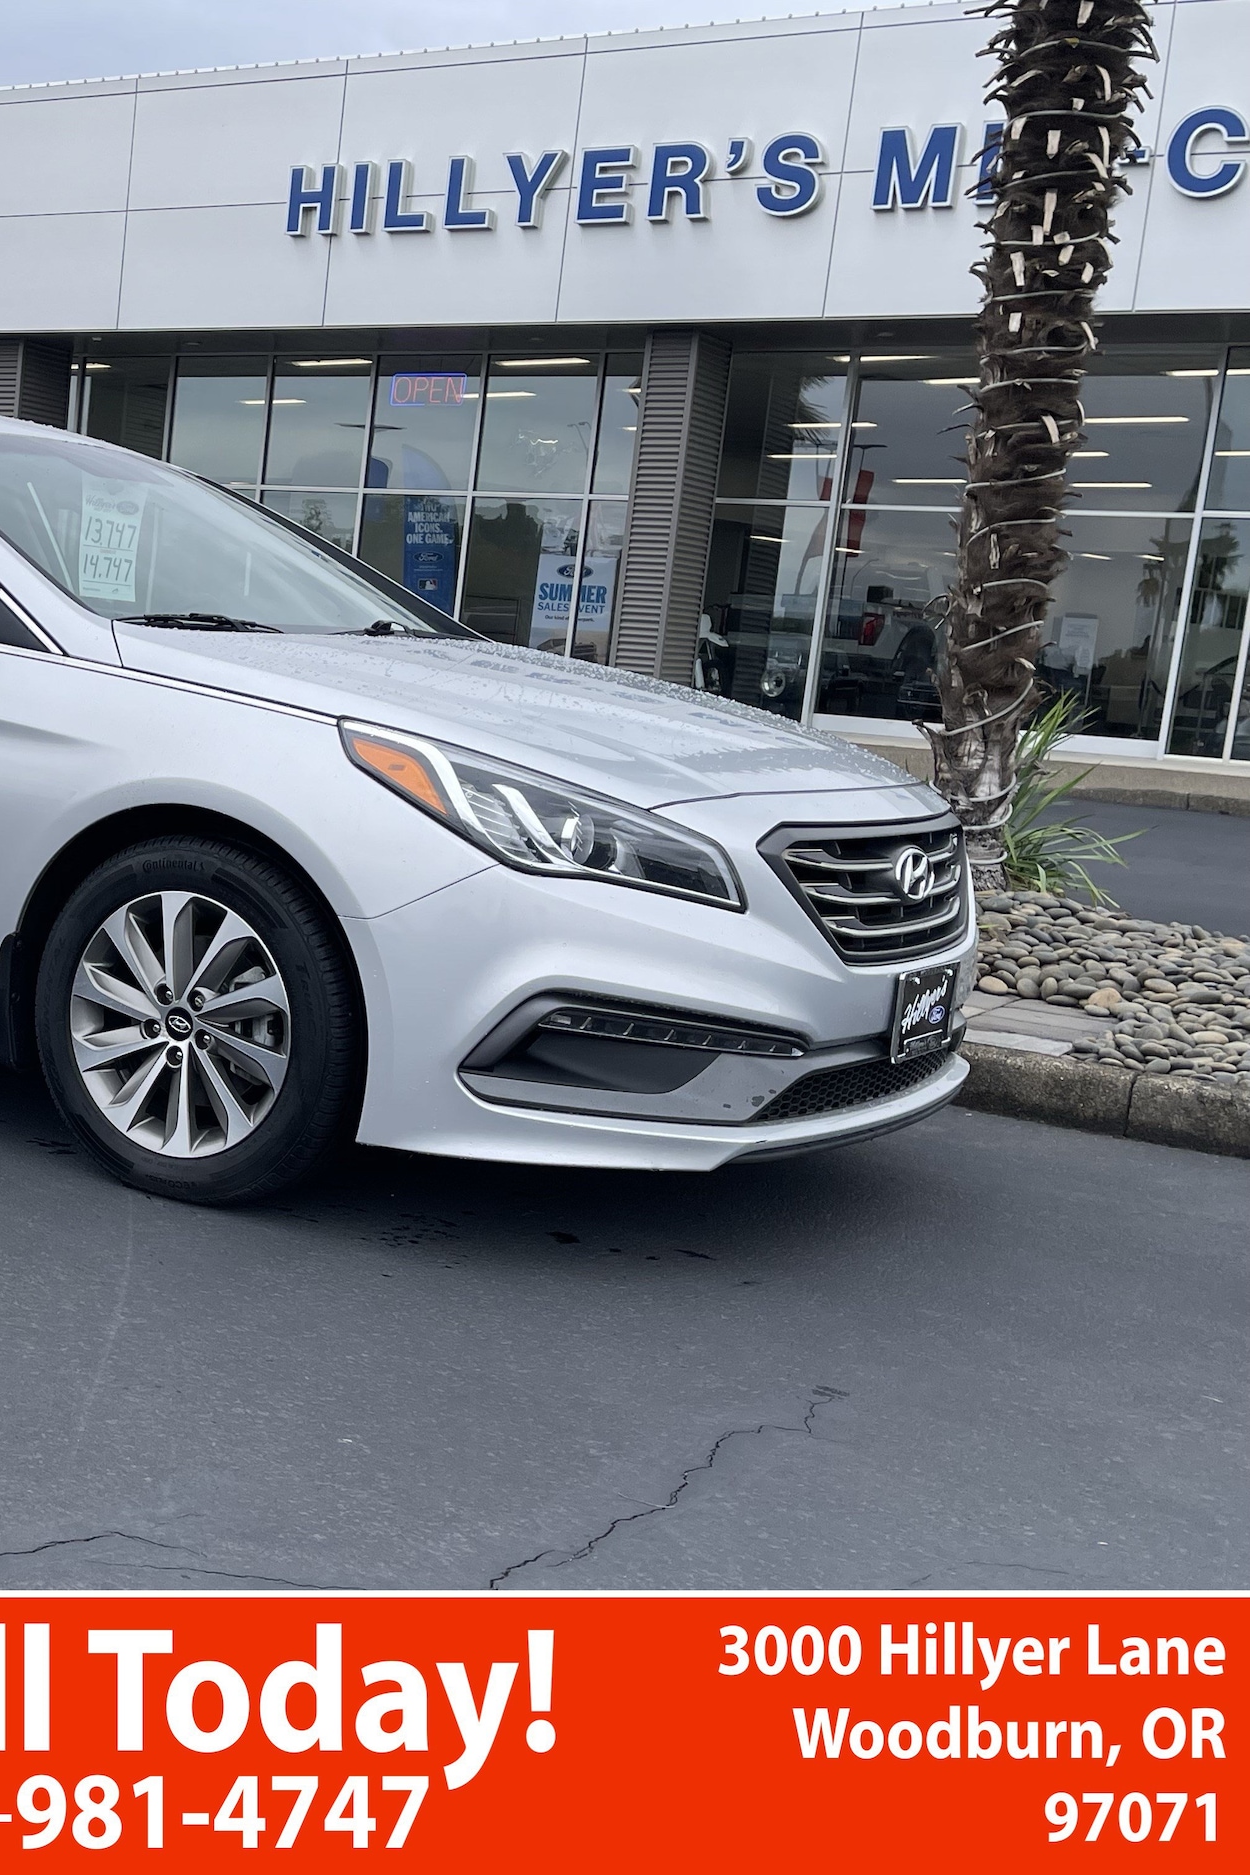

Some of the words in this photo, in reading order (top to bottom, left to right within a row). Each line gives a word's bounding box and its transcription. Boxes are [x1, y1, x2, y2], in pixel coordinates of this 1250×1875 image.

[285, 131, 831, 237] HILLYER'S
[393, 376, 464, 404] OPEN
[407, 511, 451, 523] AMERICAN
[414, 523, 443, 533] ICONS.
[406, 534, 424, 544] ONE
[537, 602, 570, 612] SALES
[578, 604, 605, 614] VENT
